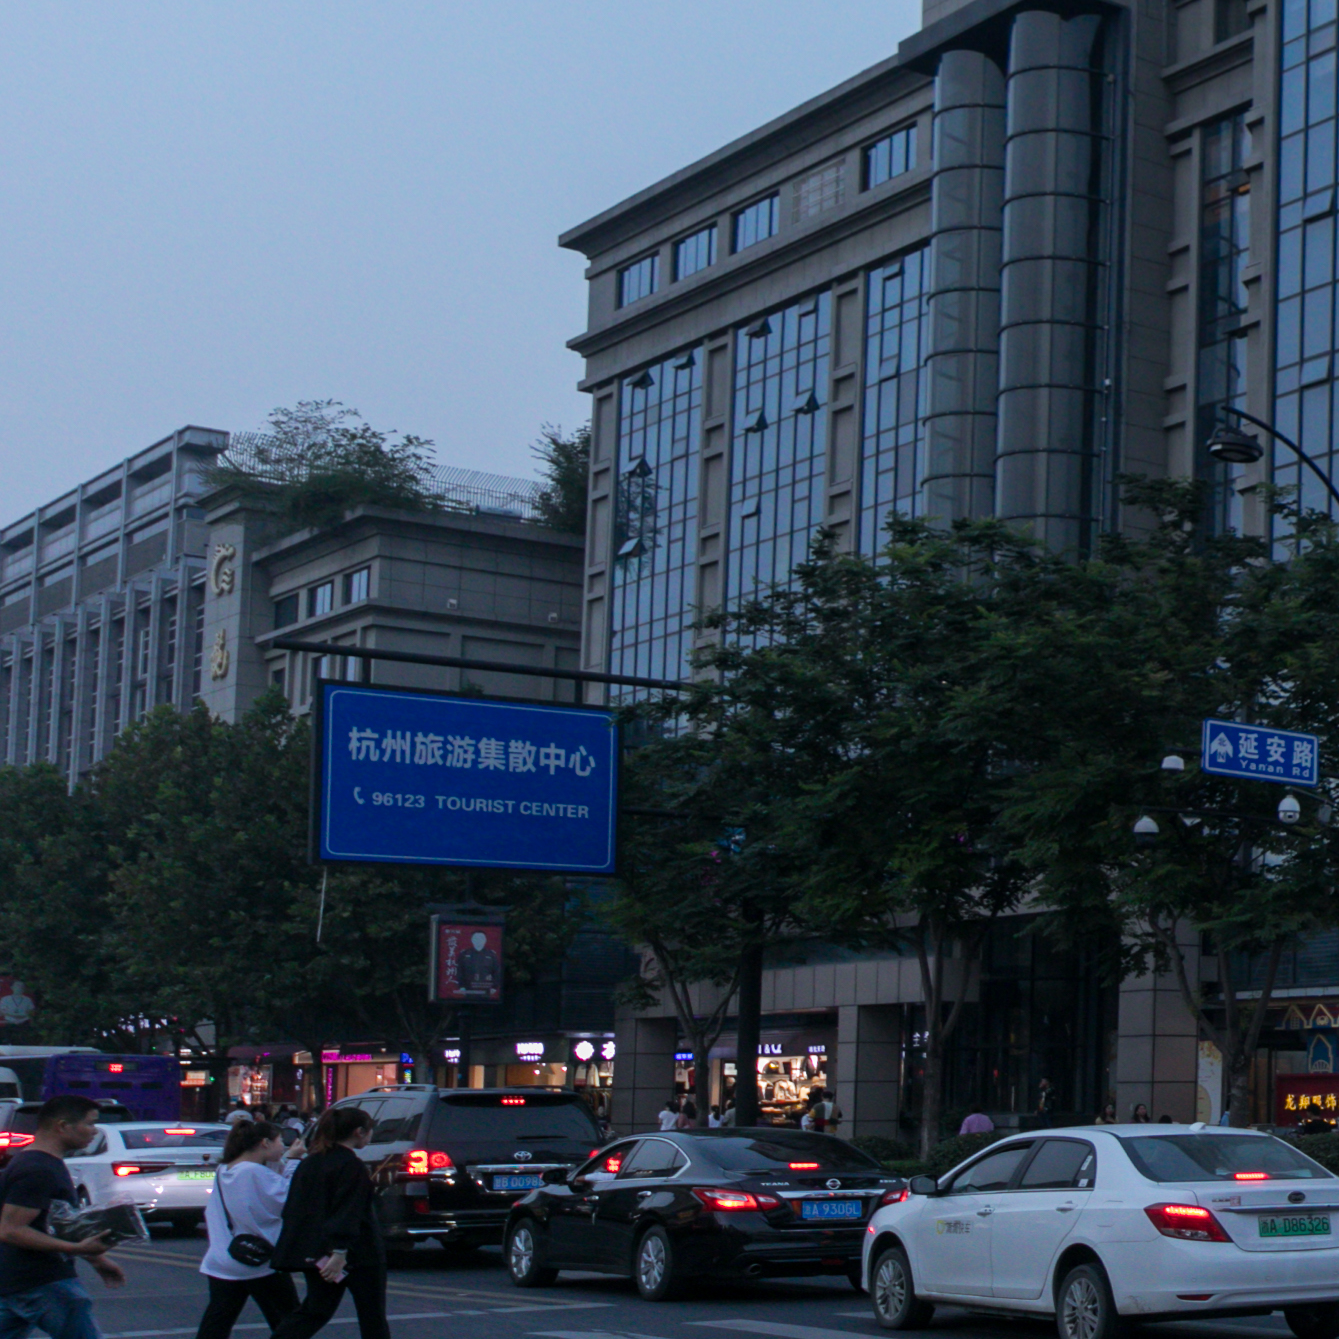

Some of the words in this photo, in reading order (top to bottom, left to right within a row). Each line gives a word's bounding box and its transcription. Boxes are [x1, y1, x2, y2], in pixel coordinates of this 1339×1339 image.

[348, 726, 596, 777] 杭州旅游集散中心
[1238, 732, 1314, 768] 延安路
[1240, 759, 1284, 774] Yan'an
[1292, 766, 1310, 778] Rd
[372, 791, 425, 808] 96123
[435, 795, 516, 814] TOURIST
[519, 801, 590, 819] CENTER
